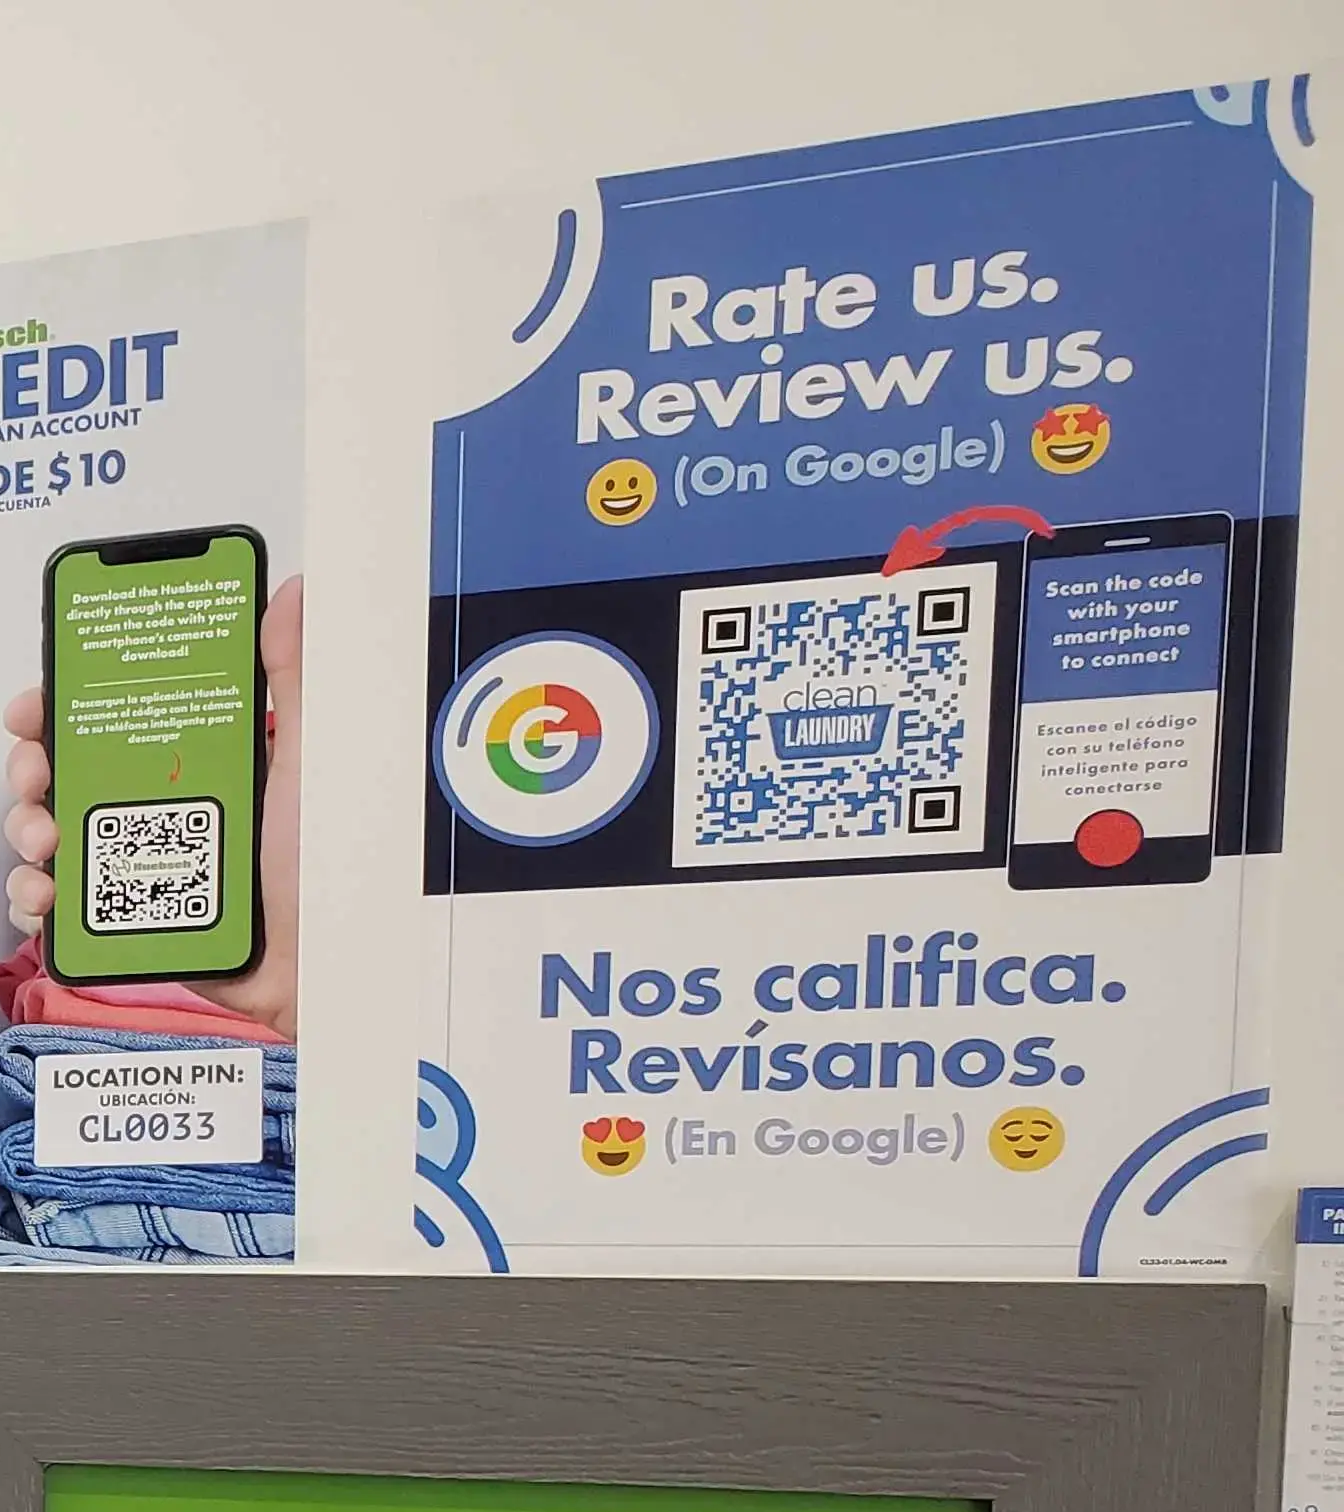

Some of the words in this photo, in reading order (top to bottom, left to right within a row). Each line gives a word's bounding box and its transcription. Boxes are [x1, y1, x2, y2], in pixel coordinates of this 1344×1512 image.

[648, 267, 878, 354] Rate
[913, 250, 1059, 318] us.
[576, 343, 954, 445] Review
[985, 329, 1134, 397] us.
[30, 408, 142, 440] ACCOUNT
[674, 455, 768, 508] (On
[784, 419, 1006, 488] Google)
[1045, 580, 1098, 598] Scan
[1105, 576, 1142, 592] the
[1149, 569, 1203, 589] code
[1067, 603, 1117, 620] with
[1124, 598, 1179, 619] your
[1052, 622, 1191, 647] smartphone
[1061, 655, 1085, 670] to
[1090, 647, 1180, 668] connect
[783, 682, 877, 711] clean
[784, 714, 876, 748] LAUNDRY
[1037, 720, 1108, 737] Escanee
[1114, 718, 1130, 732] el
[1135, 713, 1197, 732] código
[1046, 742, 1077, 756] con
[1083, 741, 1103, 754] su
[1108, 735, 1185, 752] teléfono
[1041, 760, 1139, 779] inteligente
[1144, 758, 1188, 773] para
[1065, 779, 1163, 796] conectarse
[540, 951, 724, 1018] Nos
[753, 931, 1127, 1013] califica.
[568, 1018, 1086, 1096] Revísanos.
[54, 1066, 183, 1089] LOCATION
[191, 1064, 244, 1084] PIN:
[100, 1089, 196, 1108] UBICACIÓN:
[78, 1112, 215, 1143] CL0033
[664, 1117, 737, 1162] (En
[754, 1112, 966, 1166] Google)
